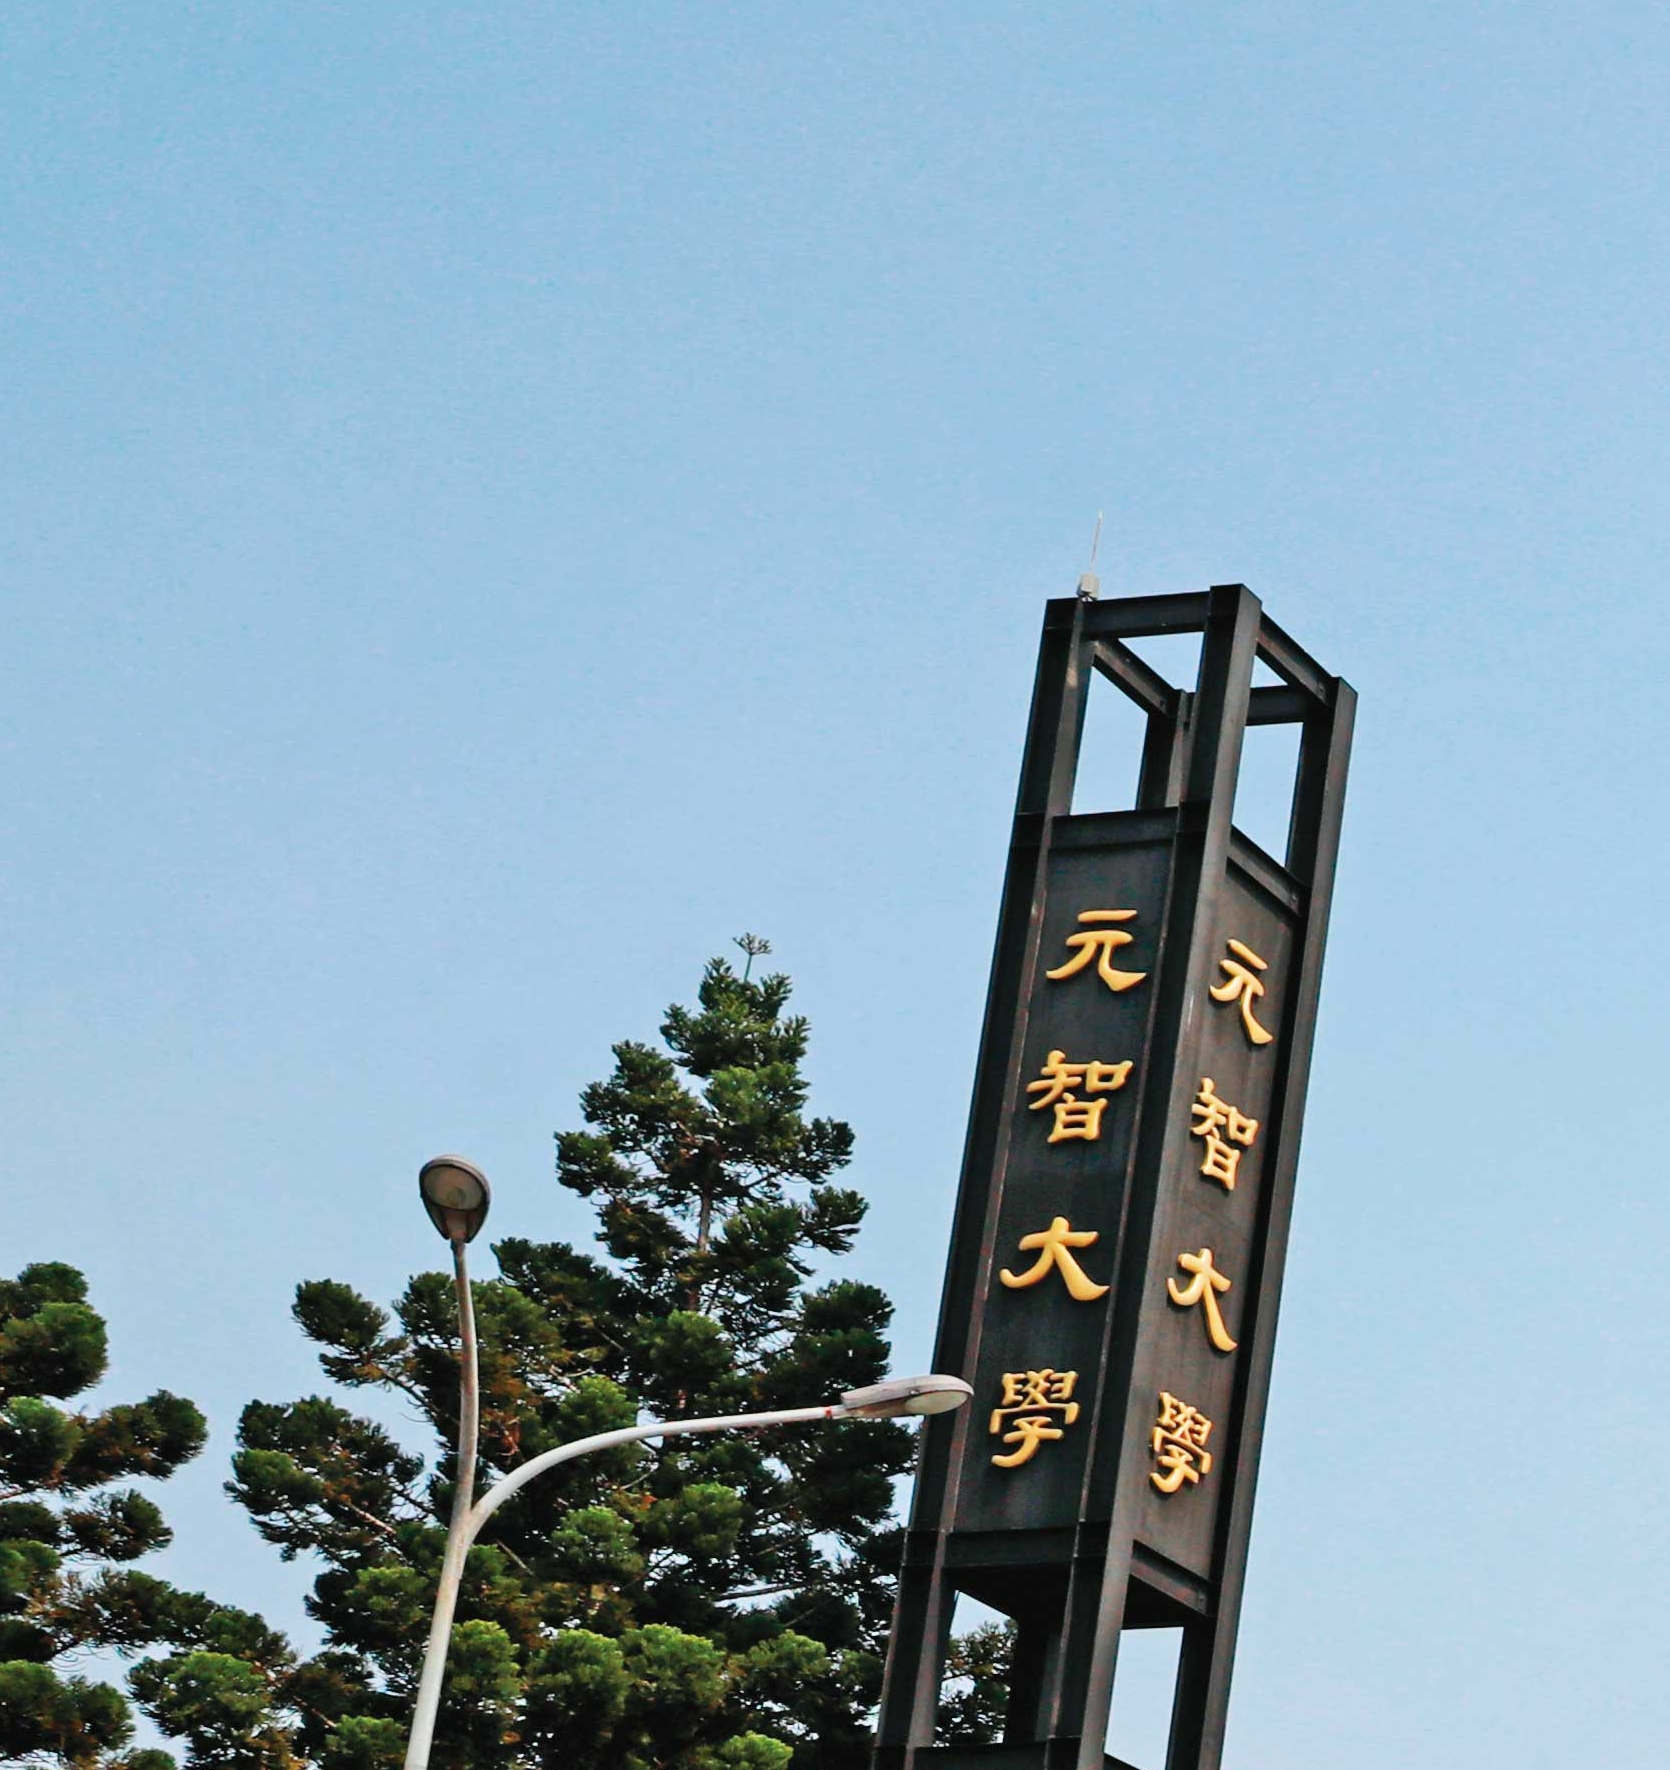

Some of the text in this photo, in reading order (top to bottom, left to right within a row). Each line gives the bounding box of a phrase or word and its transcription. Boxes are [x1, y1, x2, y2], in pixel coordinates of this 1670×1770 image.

[991, 910, 1143, 1466] 元智大學
[1149, 941, 1273, 1492] 元智大學
